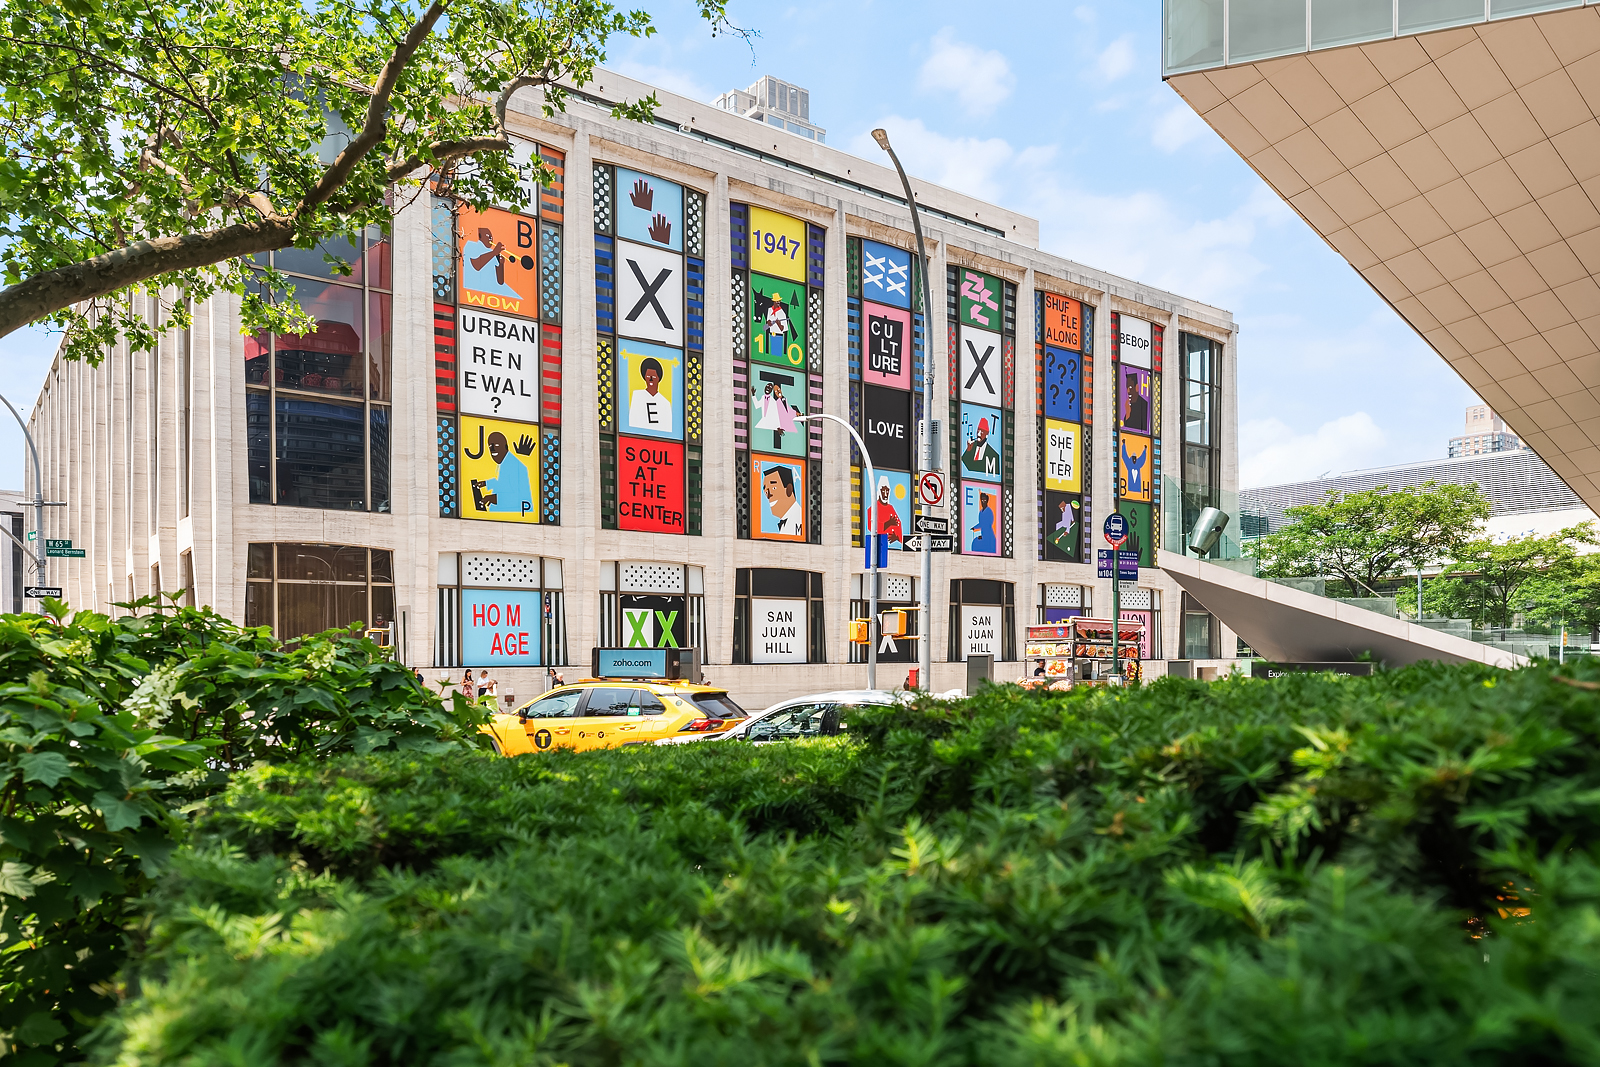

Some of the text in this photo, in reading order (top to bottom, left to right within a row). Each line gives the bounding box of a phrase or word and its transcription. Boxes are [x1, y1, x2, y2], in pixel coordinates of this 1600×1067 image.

[517, 220, 532, 248] B
[753, 230, 800, 260] 1947
[625, 258, 674, 330] X
[1046, 296, 1070, 314] SHUF
[462, 314, 534, 344] URBAN
[1062, 314, 1078, 329] FLE
[1046, 327, 1078, 345] ALONG
[1120, 333, 1150, 350] BEBOP
[881, 338, 898, 354] LT
[473, 346, 521, 370] REN
[872, 354, 899, 372] URE
[964, 340, 996, 394] X
[464, 372, 531, 397] EWAL
[490, 397, 502, 414] ?
[646, 402, 658, 424] E
[868, 419, 904, 439] LOVE
[991, 414, 999, 435] T
[464, 426, 484, 460] J
[1050, 434, 1072, 450] SHE
[625, 447, 674, 466] SOUL
[635, 466, 657, 482] AT
[754, 460, 760, 472] R
[986, 456, 996, 478] M
[1050, 462, 1071, 477] TER
[629, 482, 666, 499] THE
[1120, 478, 1127, 496] B
[1142, 482, 1150, 499] H
[966, 488, 973, 506] E
[521, 500, 530, 517] P
[619, 502, 682, 526] CENTER
[795, 523, 802, 536] M
[920, 520, 930, 529] ONE
[767, 611, 793, 622] SAN
[972, 616, 991, 626] SAN
[762, 626, 796, 638] JUAN
[968, 630, 993, 639] JUAN
[490, 632, 529, 656] AGE
[765, 642, 792, 654] HILL
[970, 643, 991, 652] HILL
[613, 658, 651, 667] zoho.com
